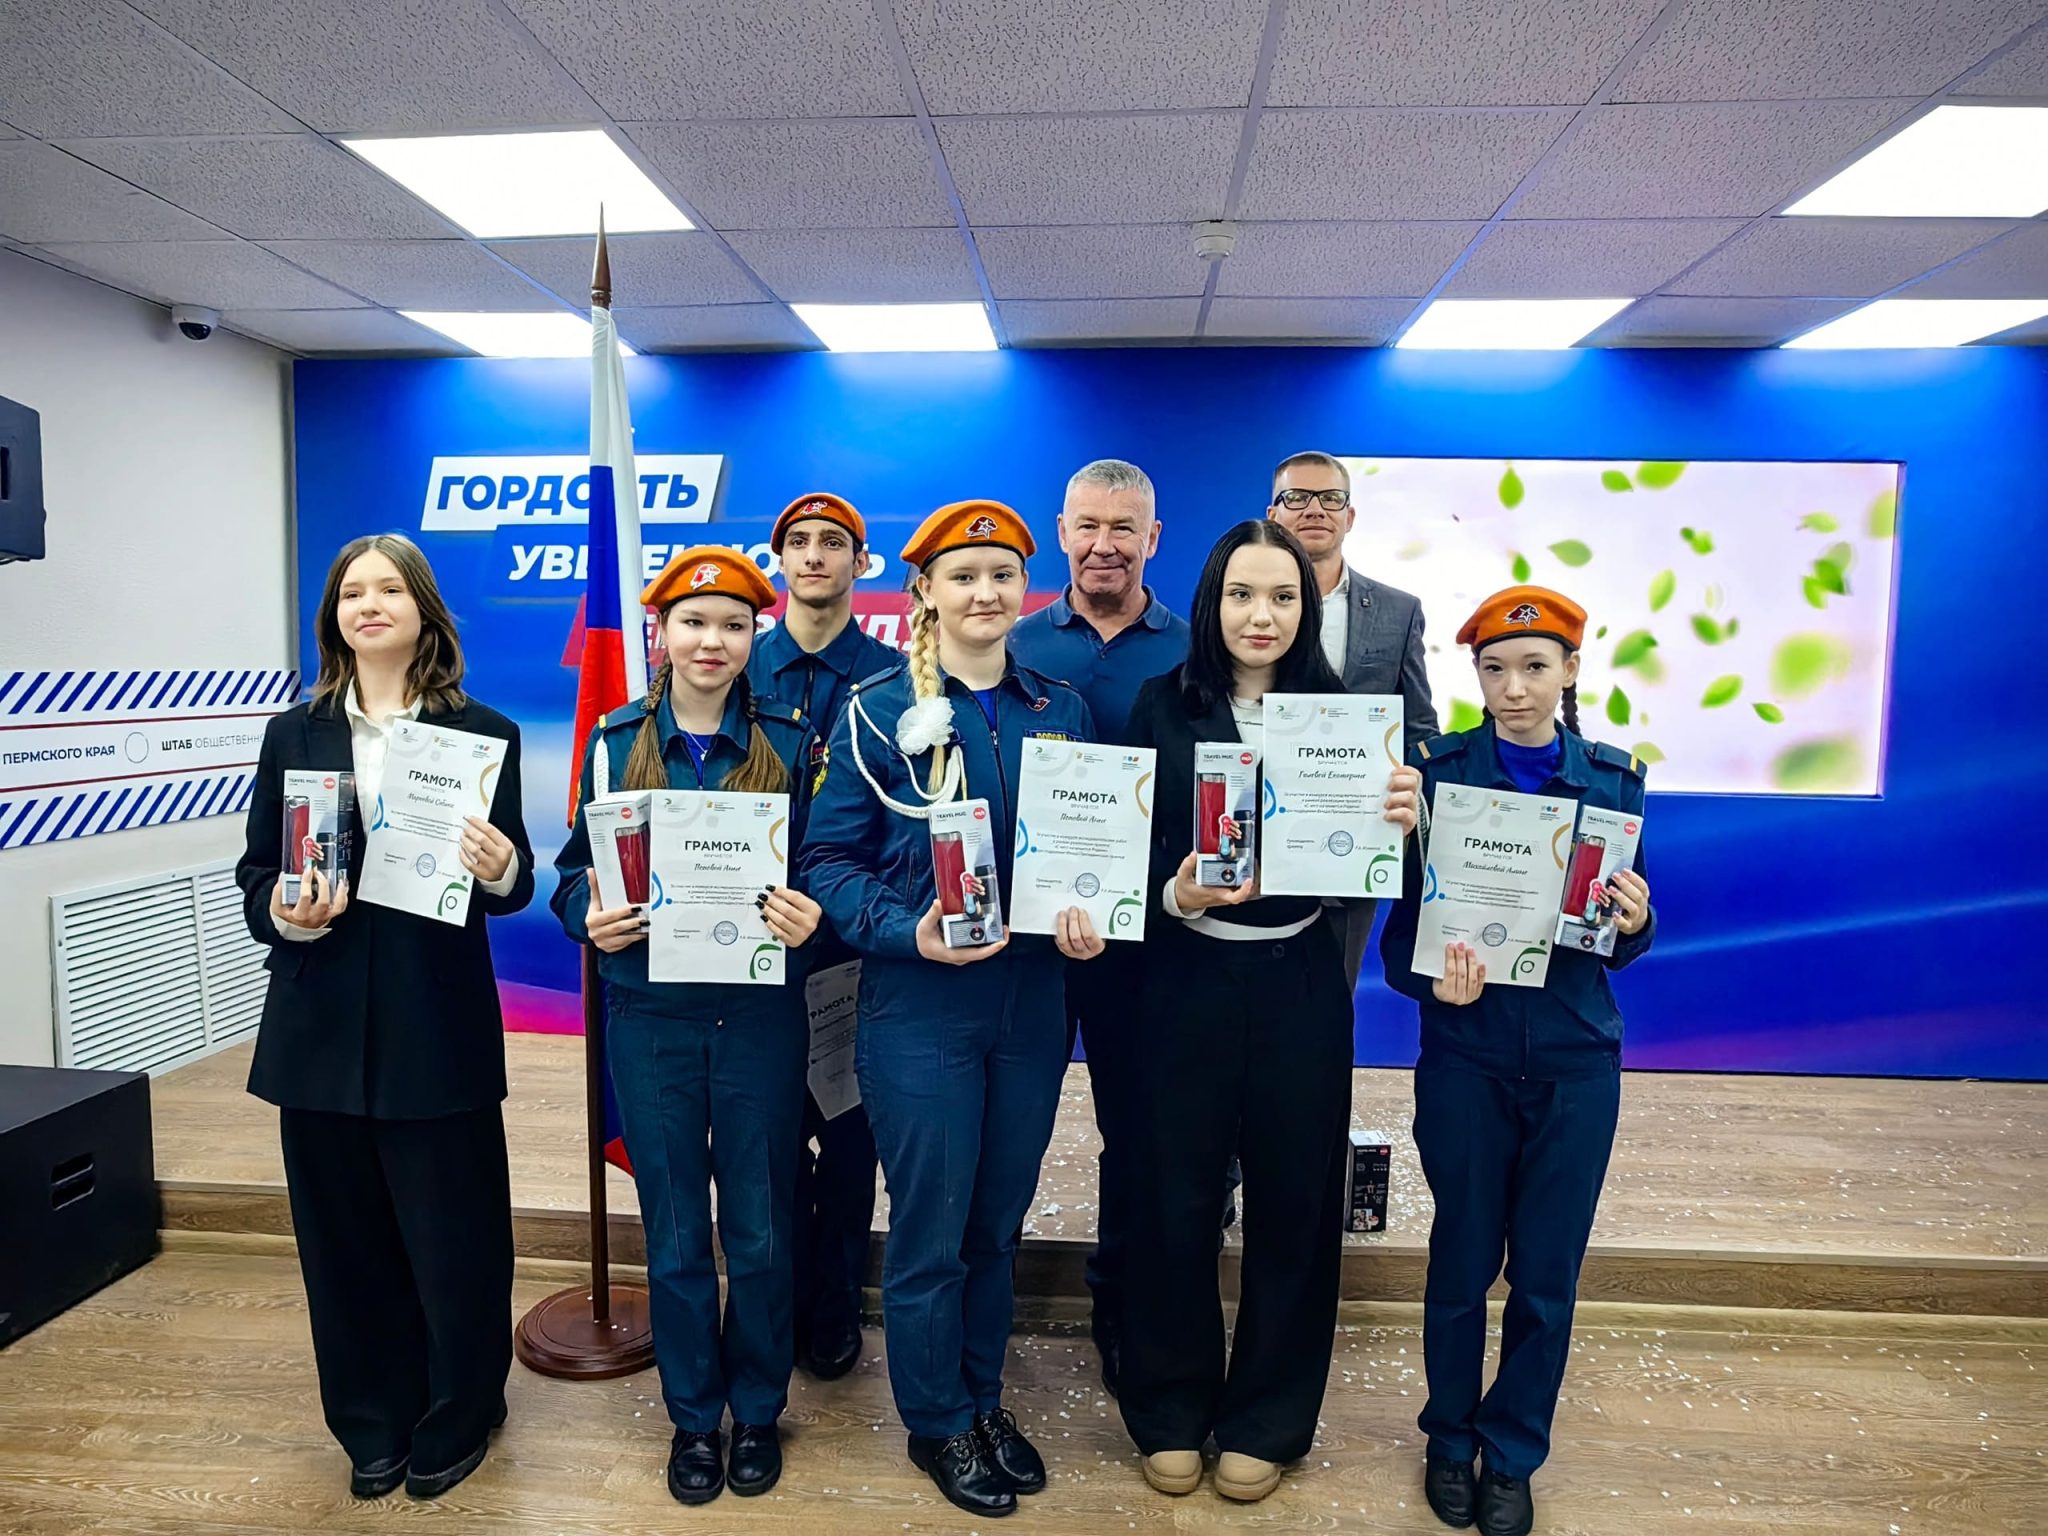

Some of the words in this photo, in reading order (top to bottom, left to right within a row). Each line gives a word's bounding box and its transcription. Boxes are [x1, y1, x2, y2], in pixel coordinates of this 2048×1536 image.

[437, 474, 699, 516] ГОРДОТЬ
[161, 739, 193, 751] ШТАБ
[1298, 747, 1367, 759] ГРАМОТА
[3, 748, 82, 765] ПЕРМСКОГО
[85, 745, 115, 758] КРАЯ
[408, 770, 462, 790] ГРАМОТА
[1052, 789, 1118, 805] ГРАМОТА
[684, 840, 752, 853] ГРАМОТА
[1464, 837, 1533, 856] ГРАМОТА
